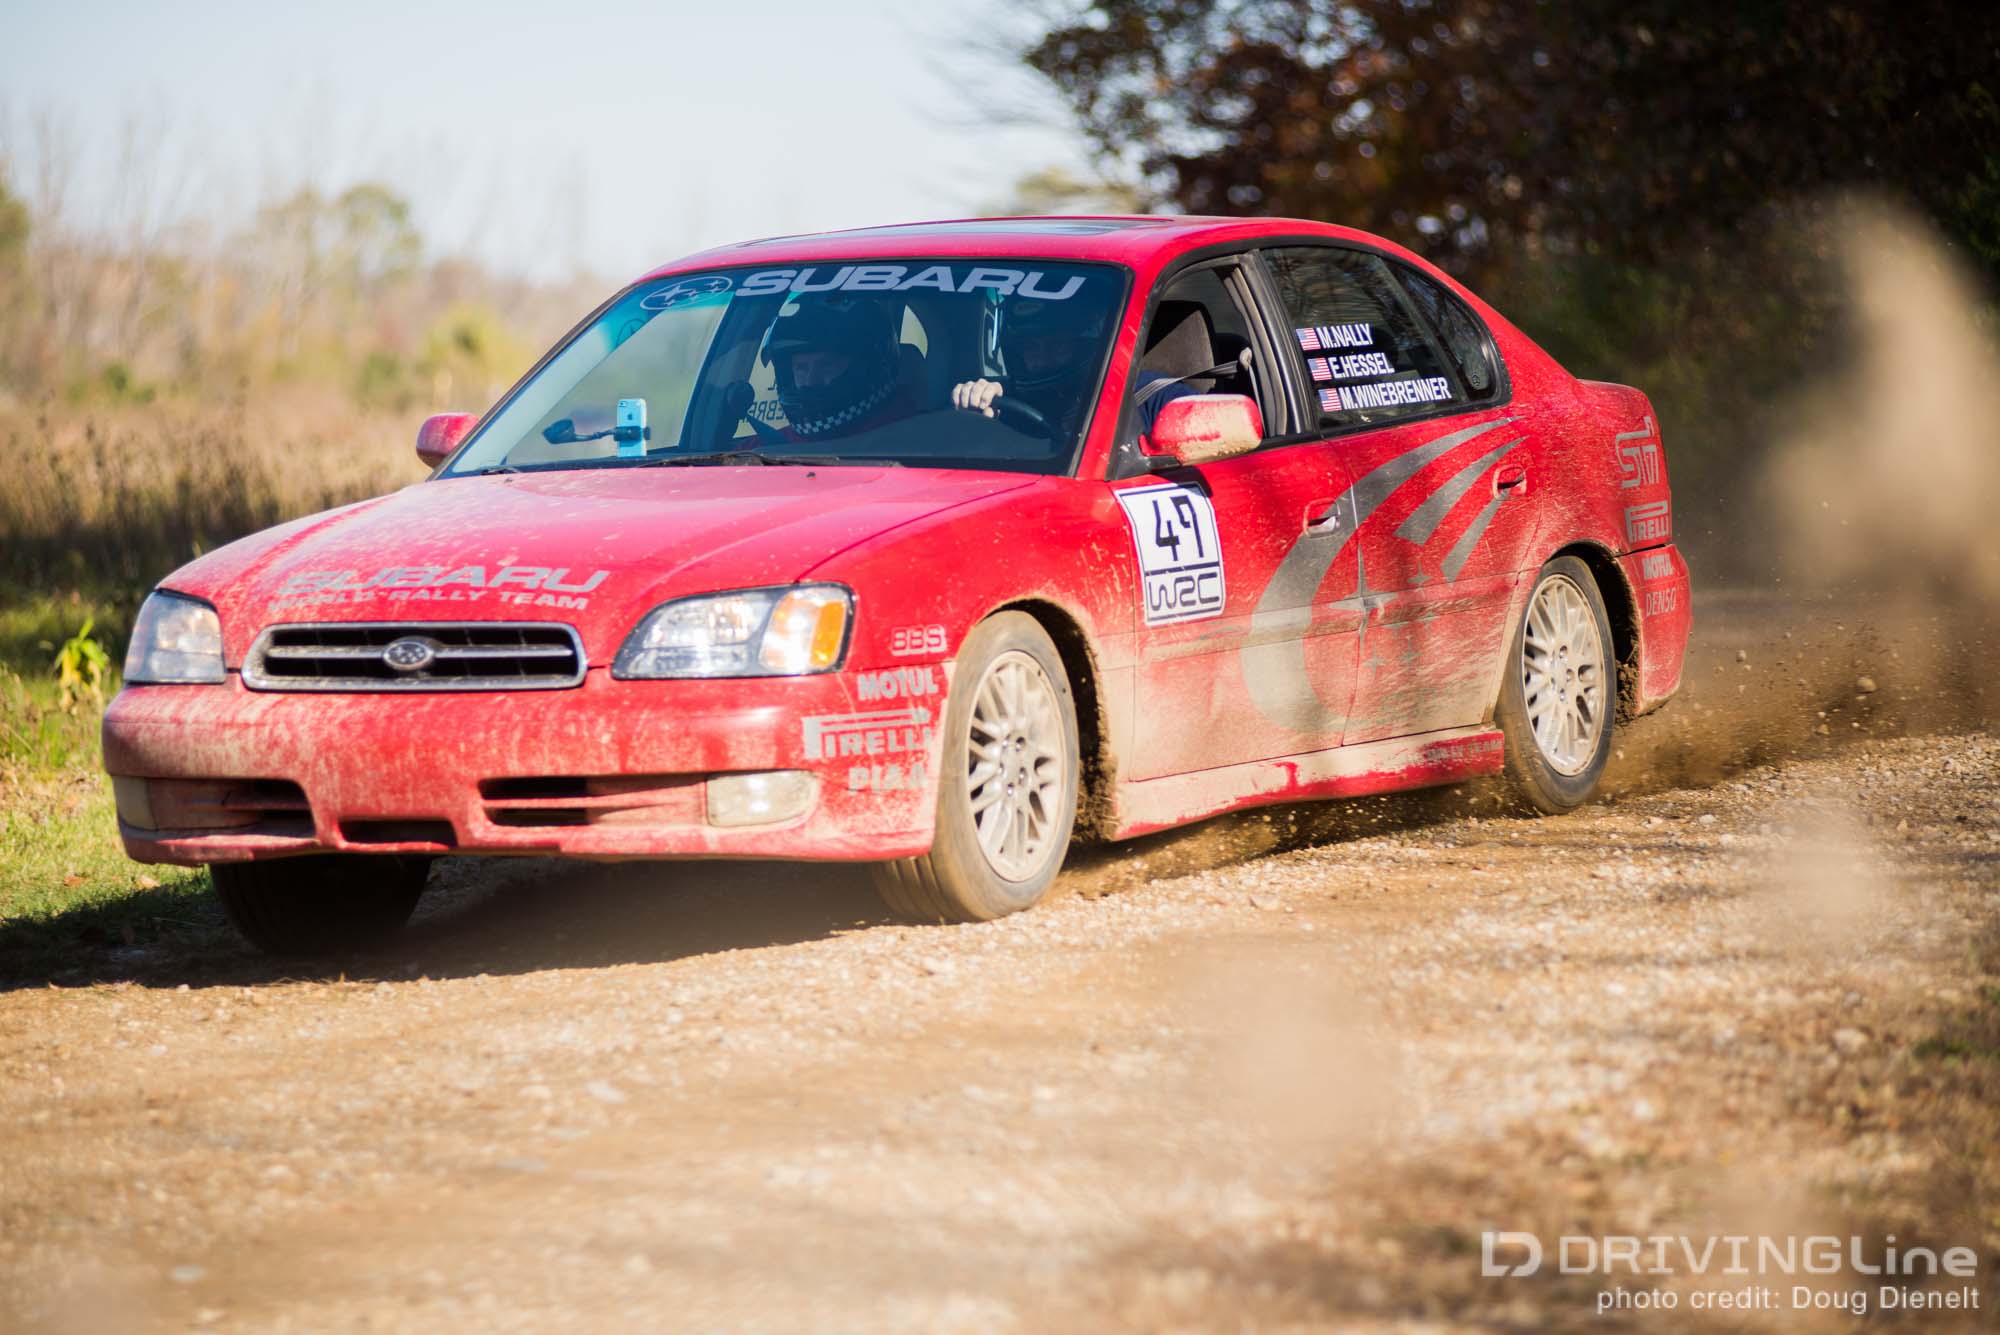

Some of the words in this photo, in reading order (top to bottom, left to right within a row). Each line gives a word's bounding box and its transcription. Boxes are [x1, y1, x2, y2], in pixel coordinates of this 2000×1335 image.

[735, 265, 1086, 300] SUBARU
[1316, 323, 1374, 349] M.NALLY
[1328, 352, 1395, 379] E.HESSEL
[1338, 376, 1452, 410] M.WINEBRENNER
[1152, 495, 1204, 561] 49
[1624, 501, 1669, 544] PIRELLI
[277, 566, 609, 594] SUBARU
[1641, 554, 1674, 580] MOTUL
[387, 589, 487, 602] RALLY
[500, 591, 588, 610] TEAM
[1149, 571, 1219, 611] WRC
[1646, 587, 1677, 617] DENSO
[890, 624, 947, 656] BBS
[857, 666, 939, 700] MOTUL
[802, 704, 932, 760] PIRELLI
[848, 762, 928, 792] PIAA
